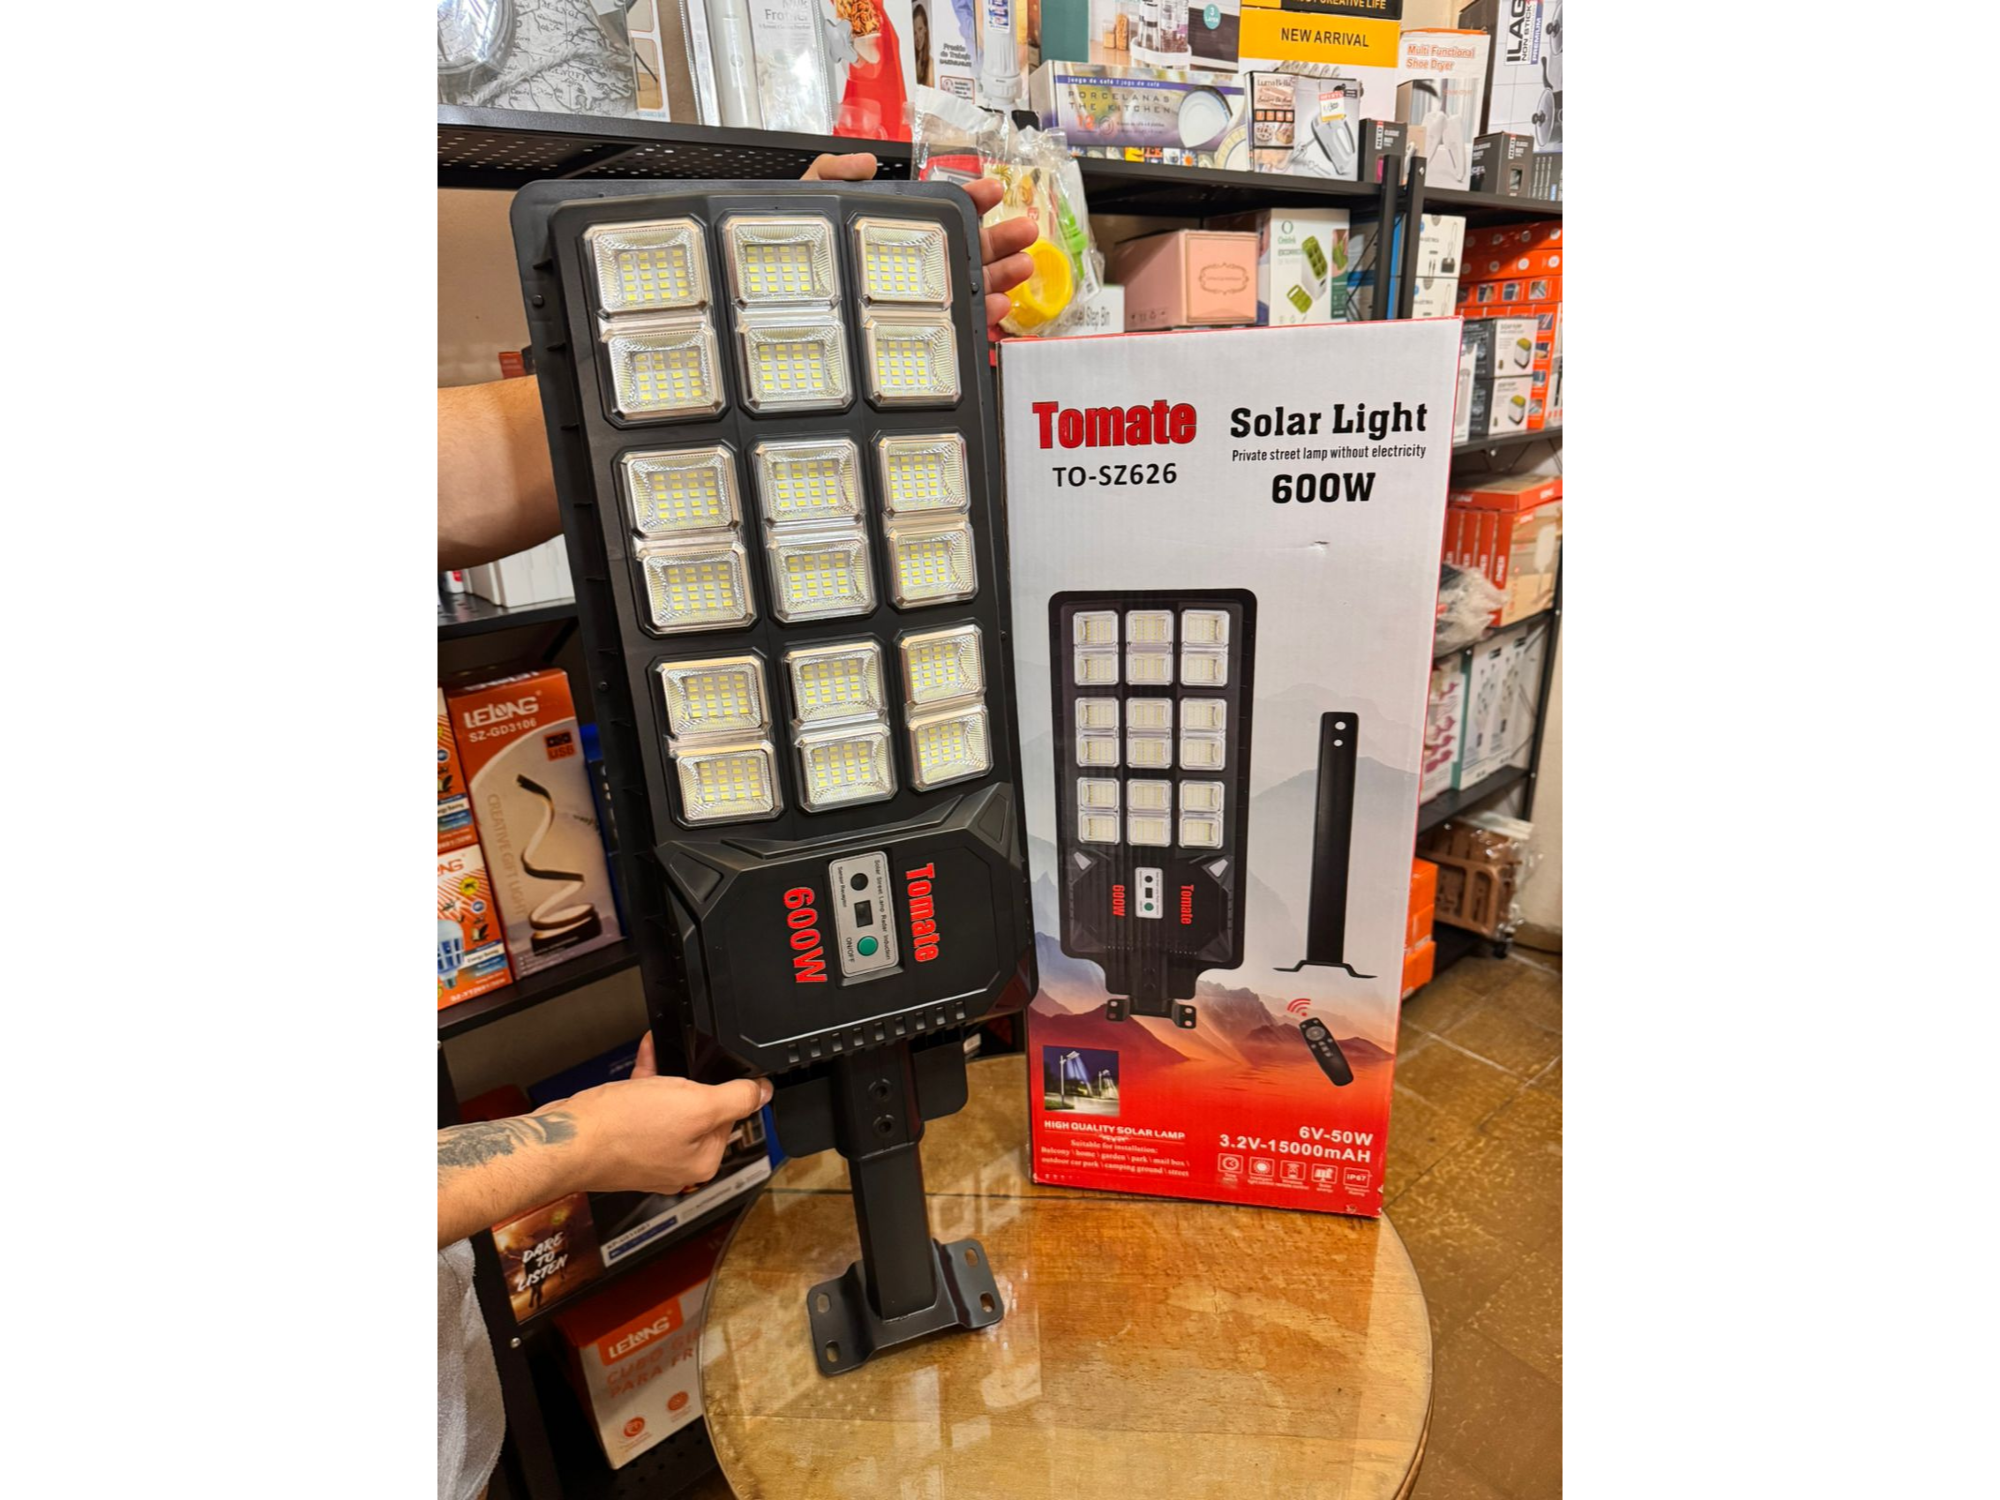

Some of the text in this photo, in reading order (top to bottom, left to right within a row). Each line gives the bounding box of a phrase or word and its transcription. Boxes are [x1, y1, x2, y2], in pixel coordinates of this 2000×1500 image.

[1209, 7, 1215, 16] 3
[1281, 27, 1370, 47] NEW ARRIVAL
[1521, 5, 1532, 61] NON STICK
[1533, 17, 1542, 61] PREMIUM
[1407, 43, 1475, 58] Multi Functional
[1406, 58, 1454, 72] Shoe Dryer
[1068, 91, 1170, 103] PORCELANAS
[1069, 102, 1172, 114] THE KITCHEN
[1032, 399, 1197, 449] Tomate
[1230, 402, 1427, 440] Solar Light
[1232, 444, 1427, 462] Private street lamp without electricity
[1052, 462, 1178, 487] TO-SZ626
[1272, 472, 1376, 504] 600W
[463, 696, 539, 728] LELONG
[549, 746, 576, 760] USB
[488, 793, 512, 848] CREATIVE
[509, 880, 527, 915] LIGHT
[876, 876, 884, 895] Street
[906, 862, 940, 962] Tomate
[1112, 884, 1125, 917] 600W
[1180, 884, 1194, 925] Tomate
[784, 887, 828, 983] 600W
[845, 937, 855, 963] ON/OFF
[1044, 1120, 1186, 1140] HIGH QUALITY SOLAR LAMP
[1299, 1126, 1374, 1146] 6V-50W
[1071, 1139, 1100, 1149] Suitable
[1102, 1142, 1113, 1150] for
[1219, 1134, 1371, 1163] 3.2V-15000mAH
[1076, 1149, 1096, 1158] home
[1153, 1157, 1169, 1165] mail
[1171, 1158, 1185, 1167] box
[1105, 1162, 1136, 1172] camping
[1137, 1165, 1163, 1175] ground
[1346, 1174, 1367, 1182] IP67
[522, 1231, 564, 1264] DARE
[536, 1251, 555, 1267] TO
[516, 1254, 568, 1292] LISTEN
[608, 1316, 670, 1359] LELONG
